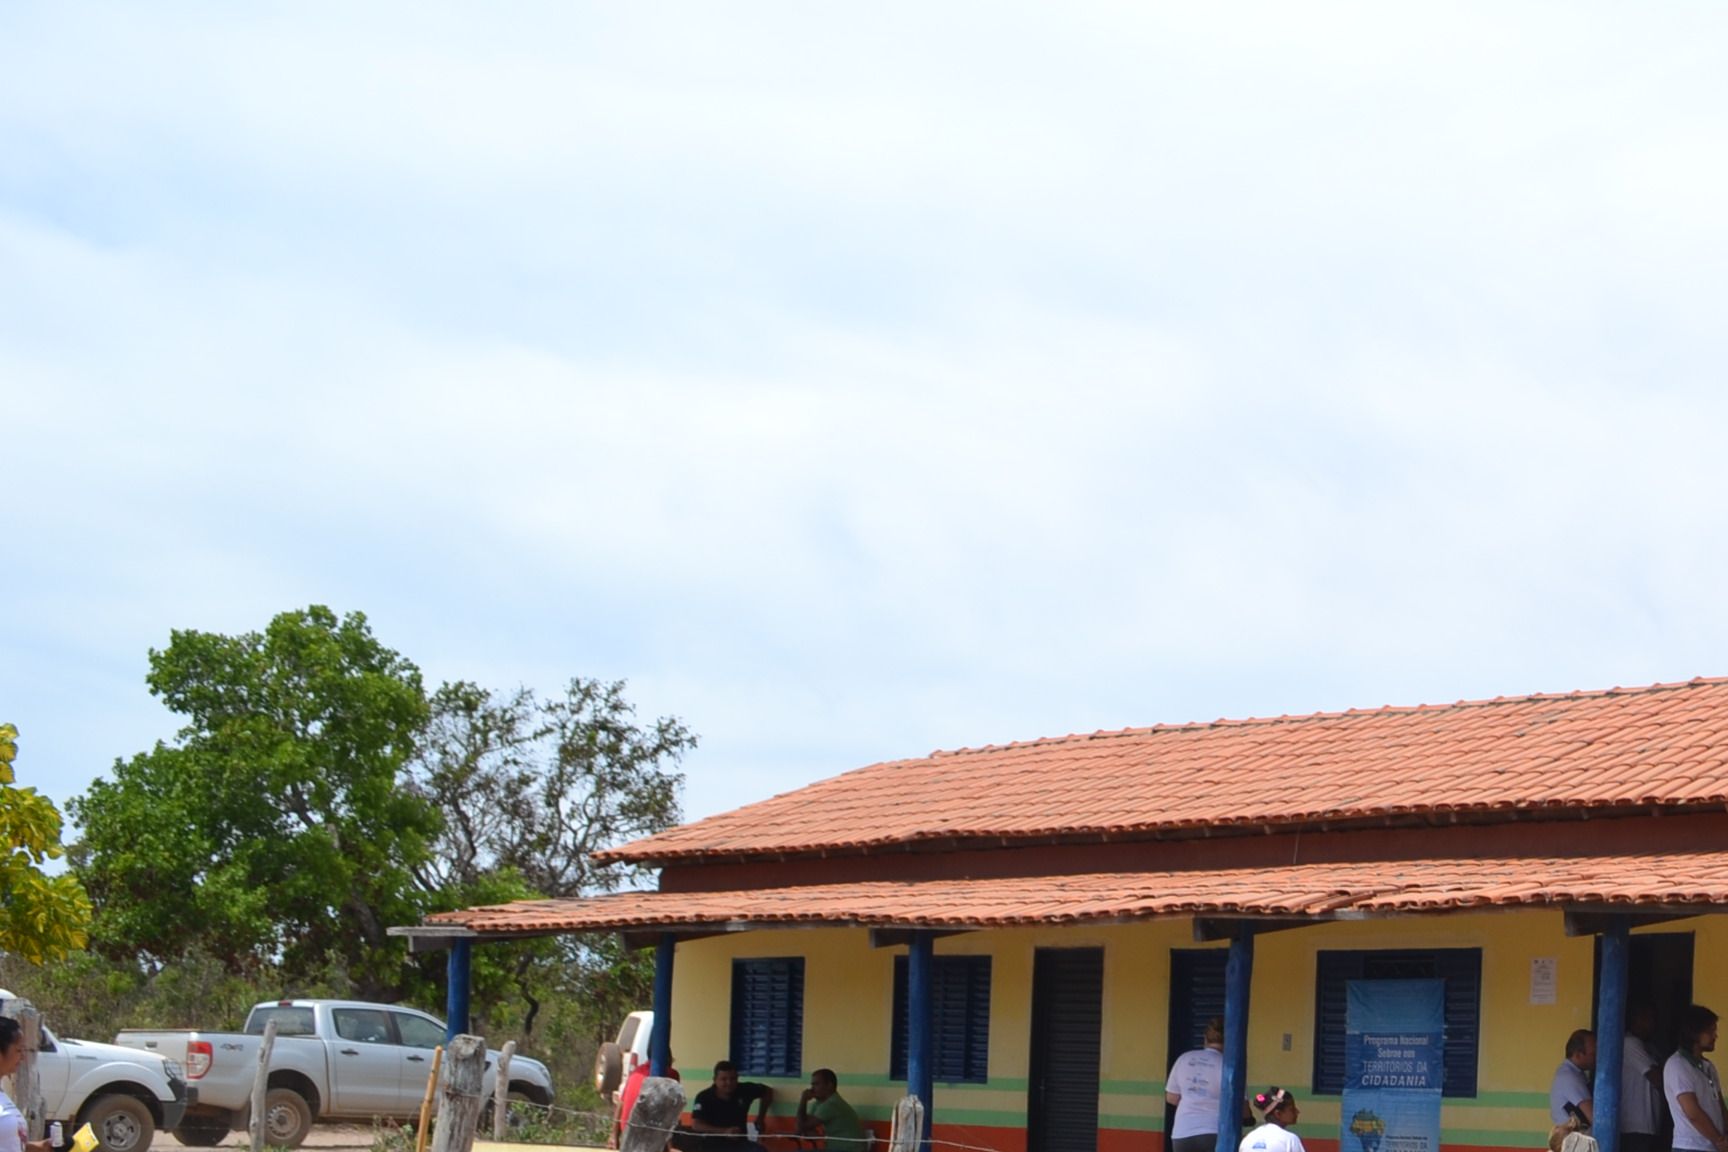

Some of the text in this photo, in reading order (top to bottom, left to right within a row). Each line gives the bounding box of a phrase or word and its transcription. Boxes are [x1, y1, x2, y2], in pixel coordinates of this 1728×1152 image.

[1363, 1034, 1429, 1047] Programa Nacional
[1417, 1061, 1427, 1072] DA
[1361, 1075, 1426, 1086] CIDADANIA
